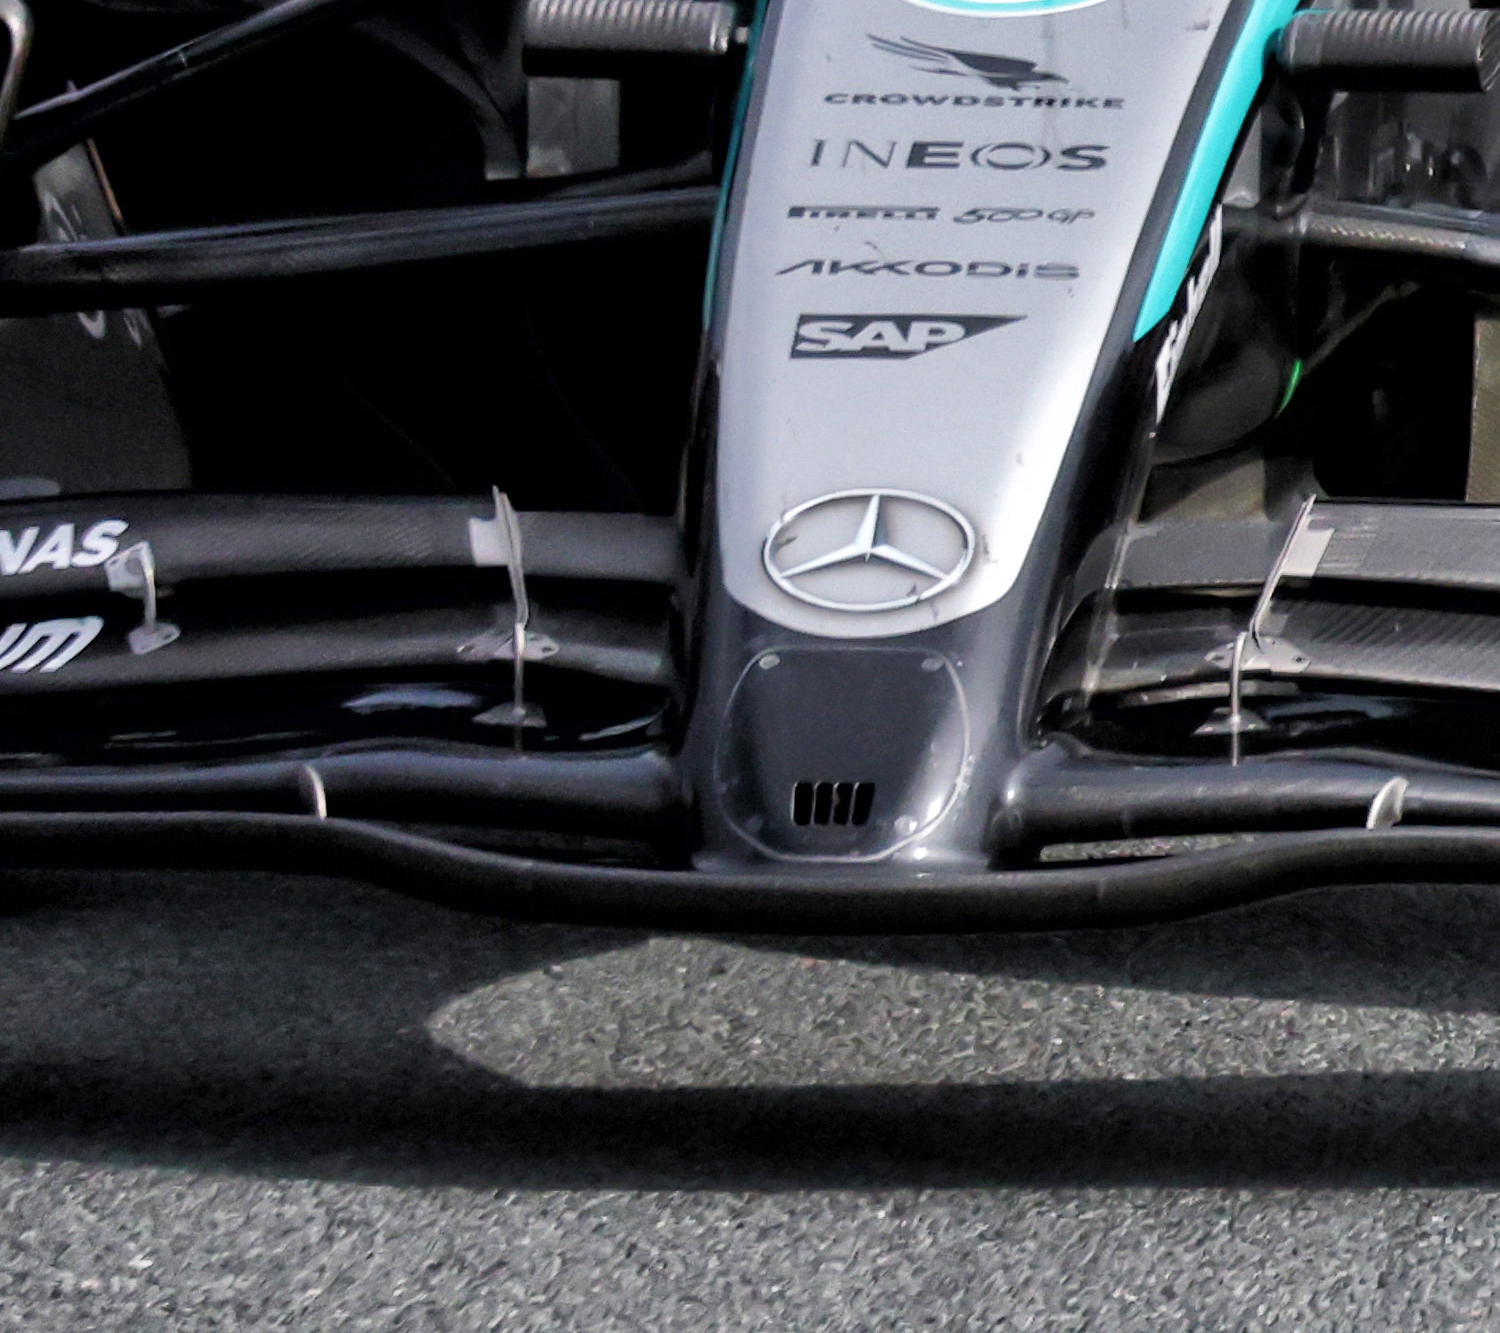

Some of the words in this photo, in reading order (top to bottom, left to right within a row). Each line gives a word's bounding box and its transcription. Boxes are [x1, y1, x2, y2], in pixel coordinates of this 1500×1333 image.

[824, 92, 1125, 109] CROWDSTRIKE
[808, 139, 1108, 170] INEOS
[787, 206, 940, 219] PIRELLI
[795, 320, 966, 353] SAP
